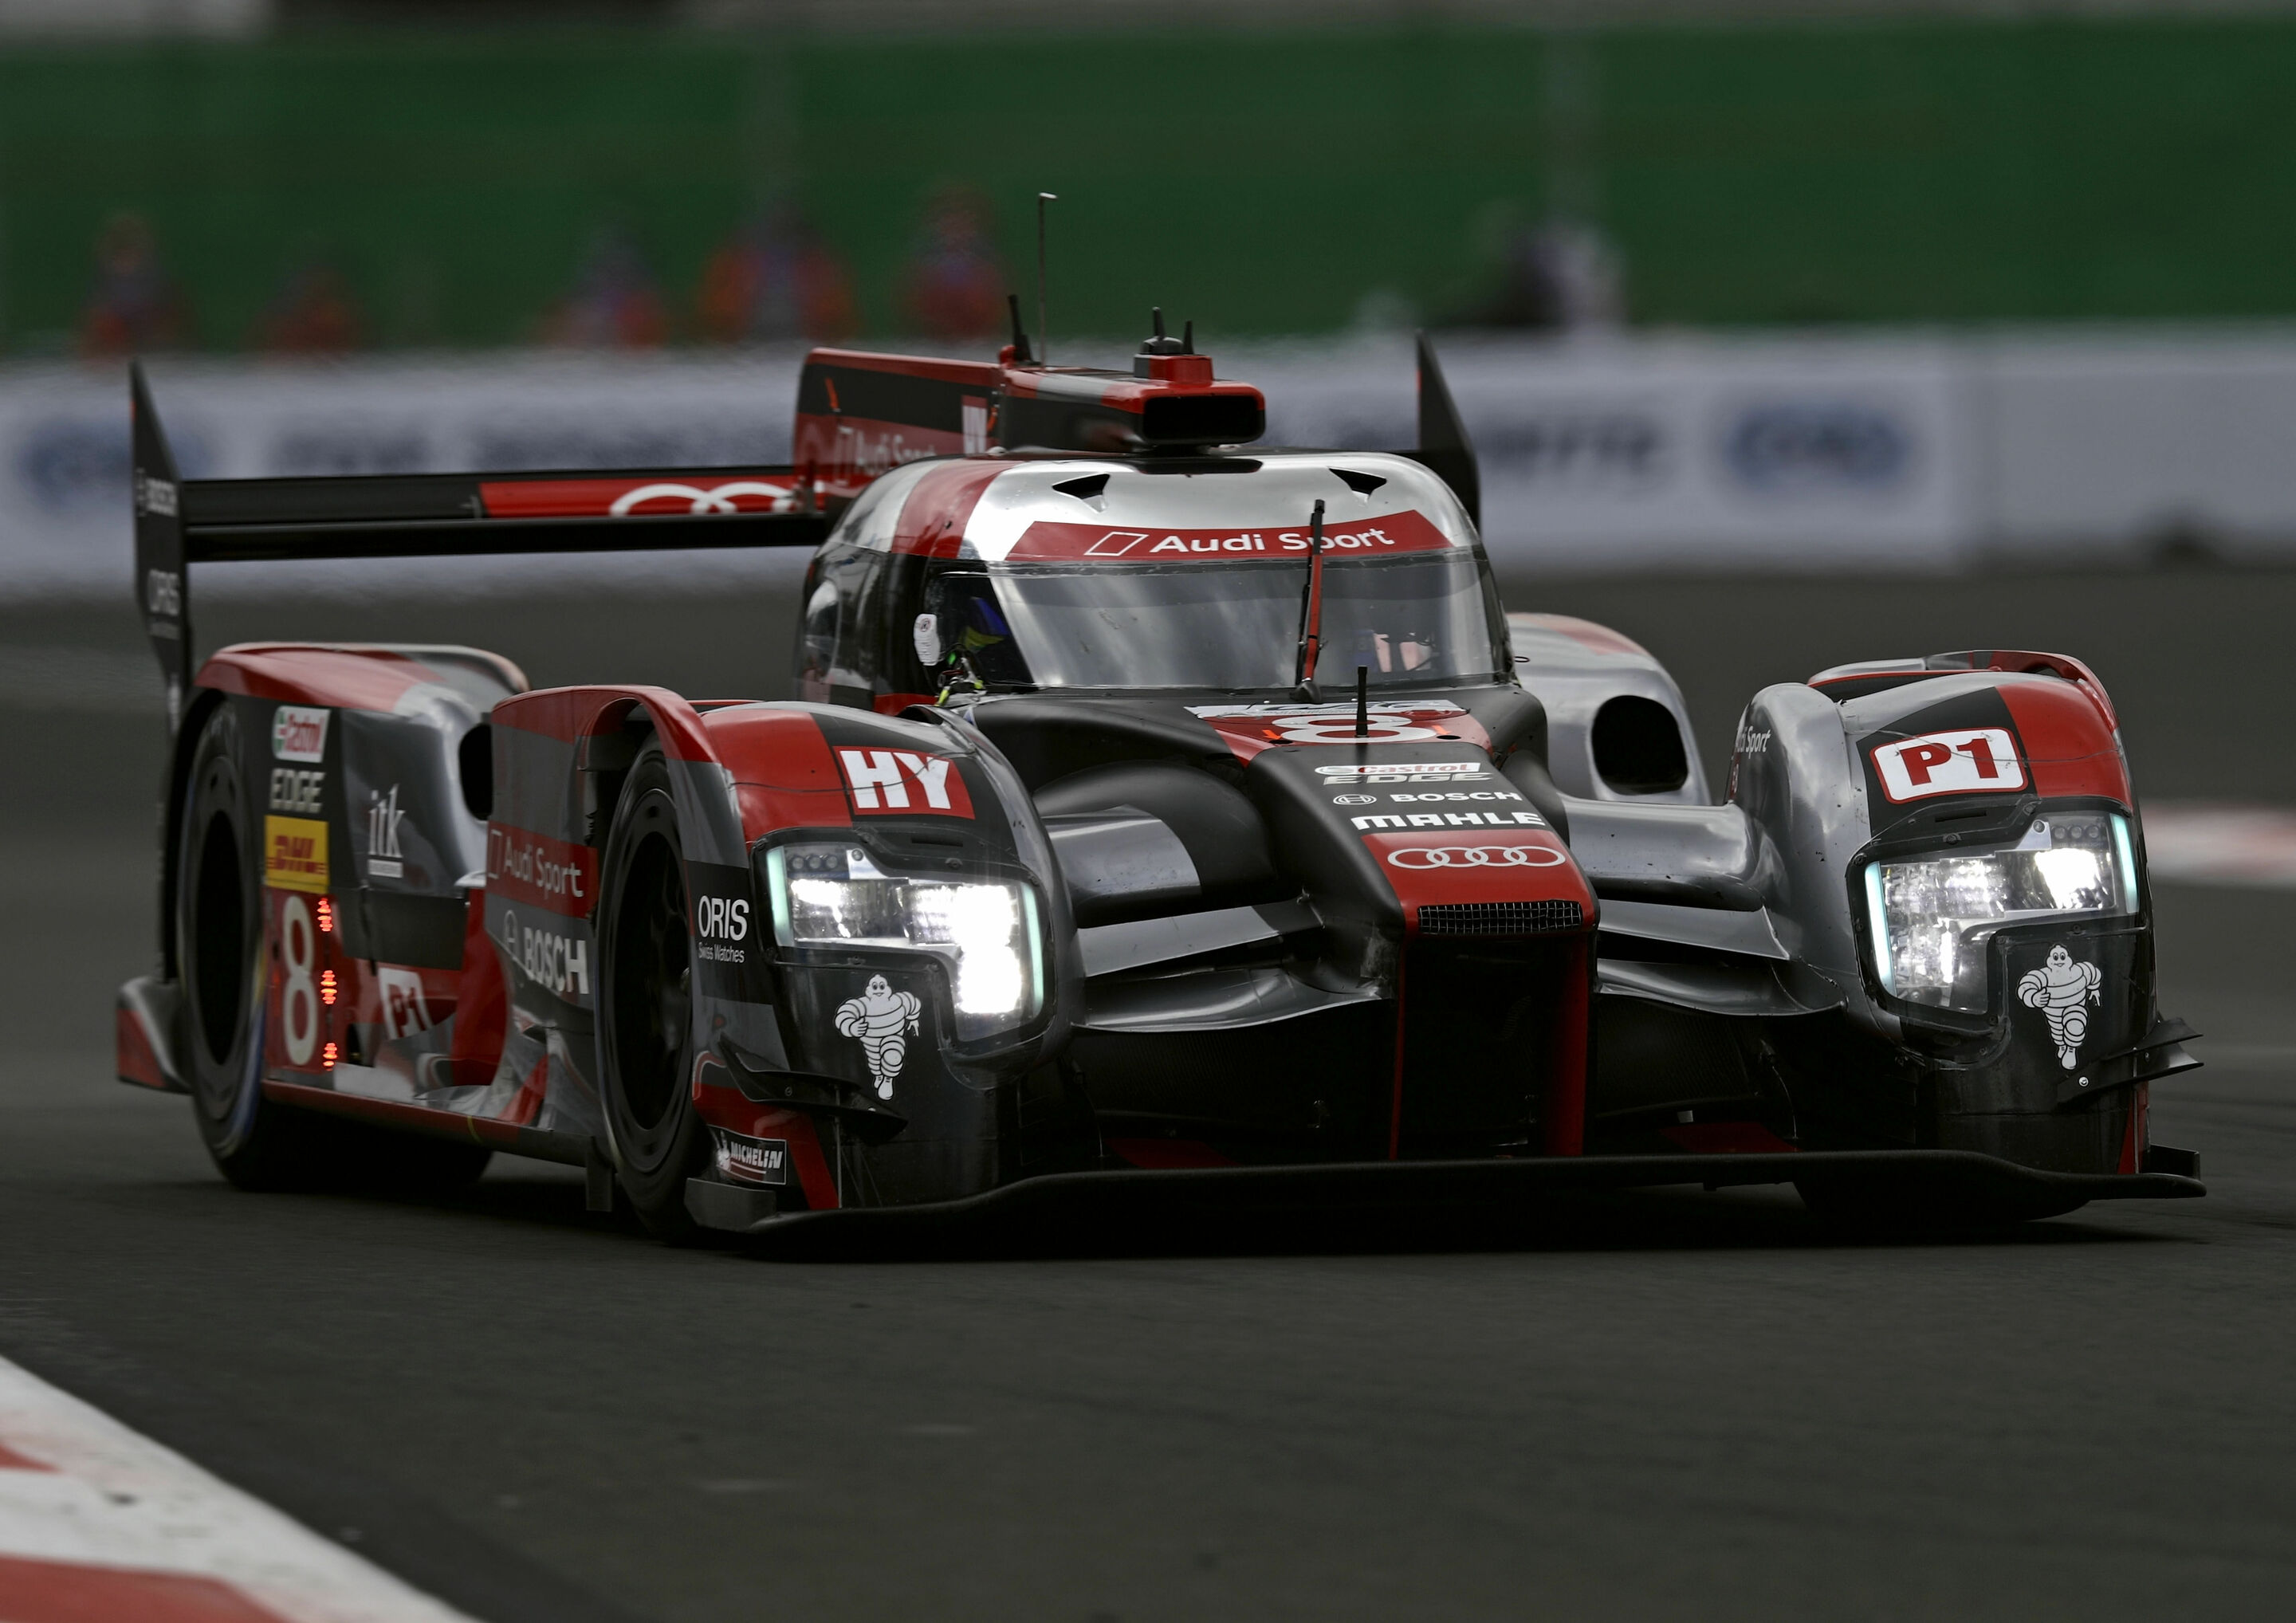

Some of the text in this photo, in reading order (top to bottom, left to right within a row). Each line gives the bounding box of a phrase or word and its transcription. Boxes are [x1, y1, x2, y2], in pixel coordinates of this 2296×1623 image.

[1149, 527, 1396, 554] Audi Sport
[1272, 714, 1437, 743] 8
[1745, 725, 1771, 759] Sport
[1357, 764, 1474, 773] Castrol
[1899, 738, 1999, 786] P1
[839, 750, 952, 810] HY
[1323, 772, 1493, 785] EDGE
[1390, 792, 1523, 803] BOSCH
[368, 782, 406, 859] itk
[1350, 812, 1546, 831] MAHLE
[503, 836, 585, 900] Audi Sport
[698, 894, 750, 941] ORIS
[524, 925, 590, 995] BOSCH
[698, 941, 746, 964] Swiss Watches
[282, 894, 319, 1067] 8
[730, 1141, 784, 1170] MICHELIN
